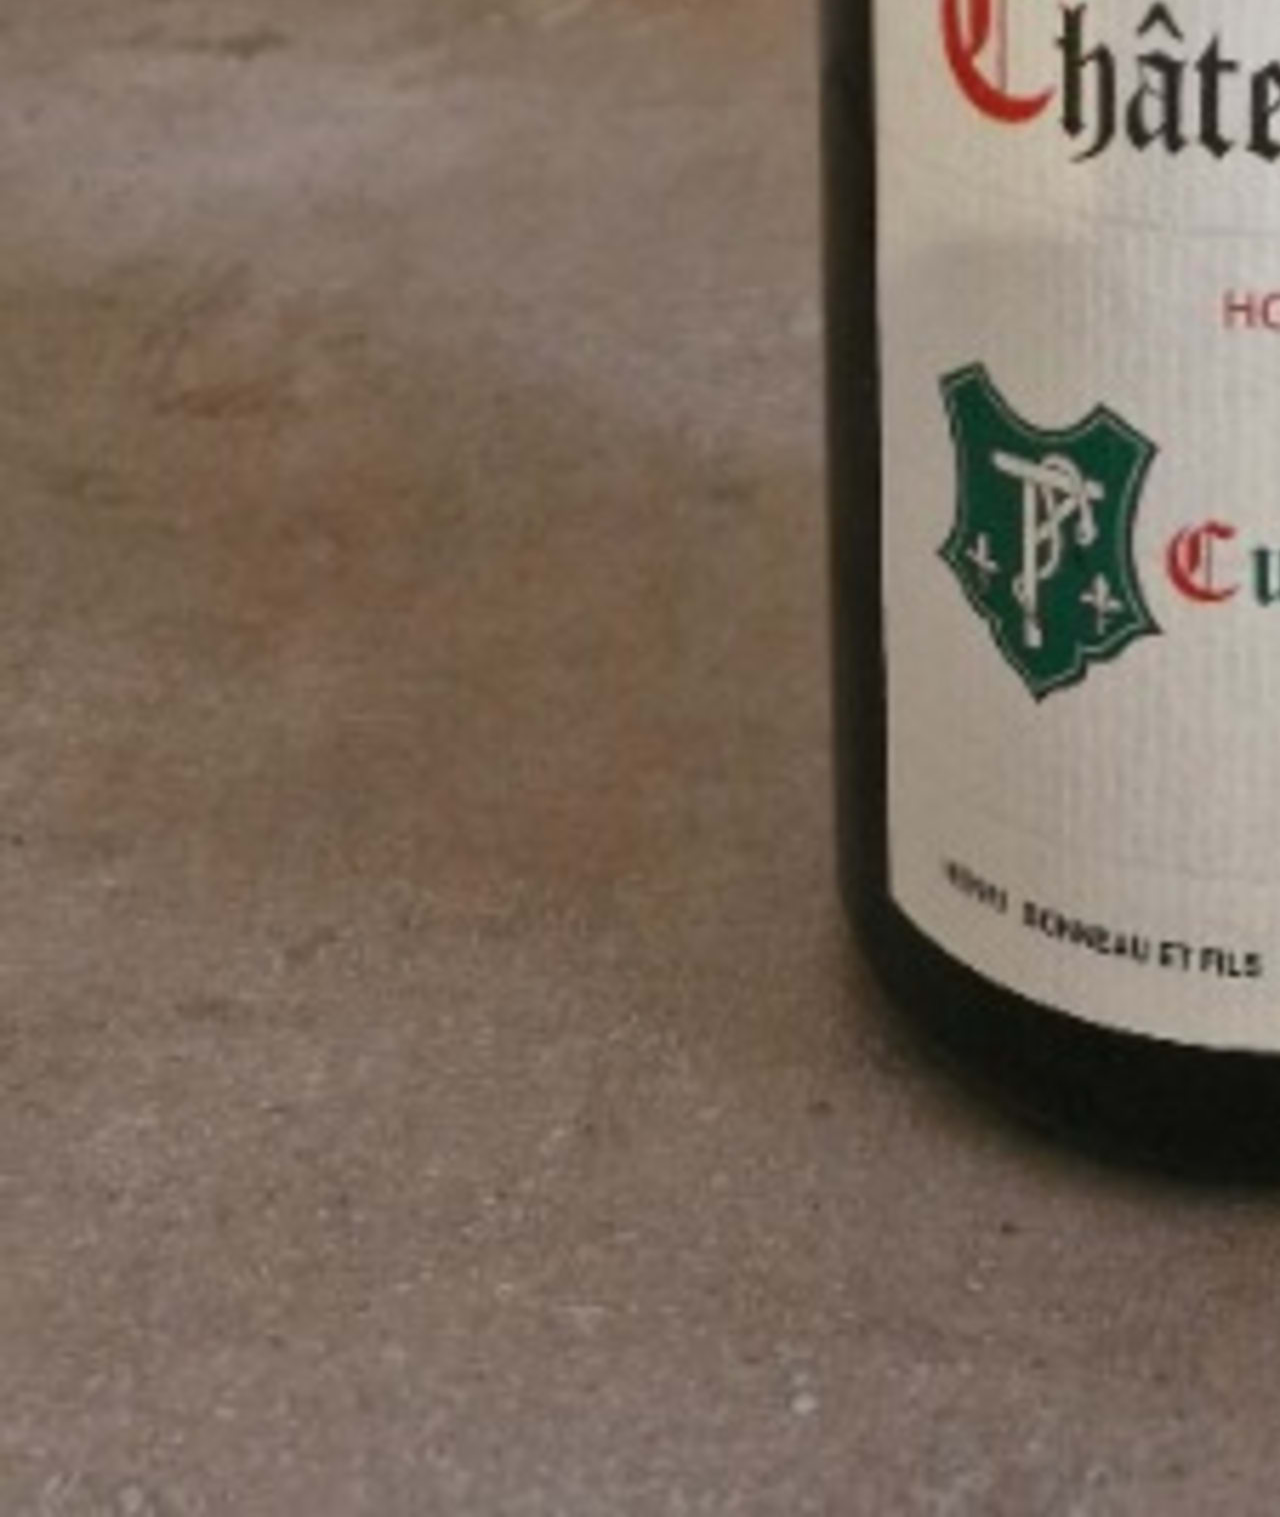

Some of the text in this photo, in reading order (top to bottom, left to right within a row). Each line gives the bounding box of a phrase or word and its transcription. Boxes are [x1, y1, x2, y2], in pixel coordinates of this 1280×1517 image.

[1022, 900, 1149, 963] BONNEAU
[1158, 940, 1193, 971] ET
[1199, 946, 1262, 978] FILS
